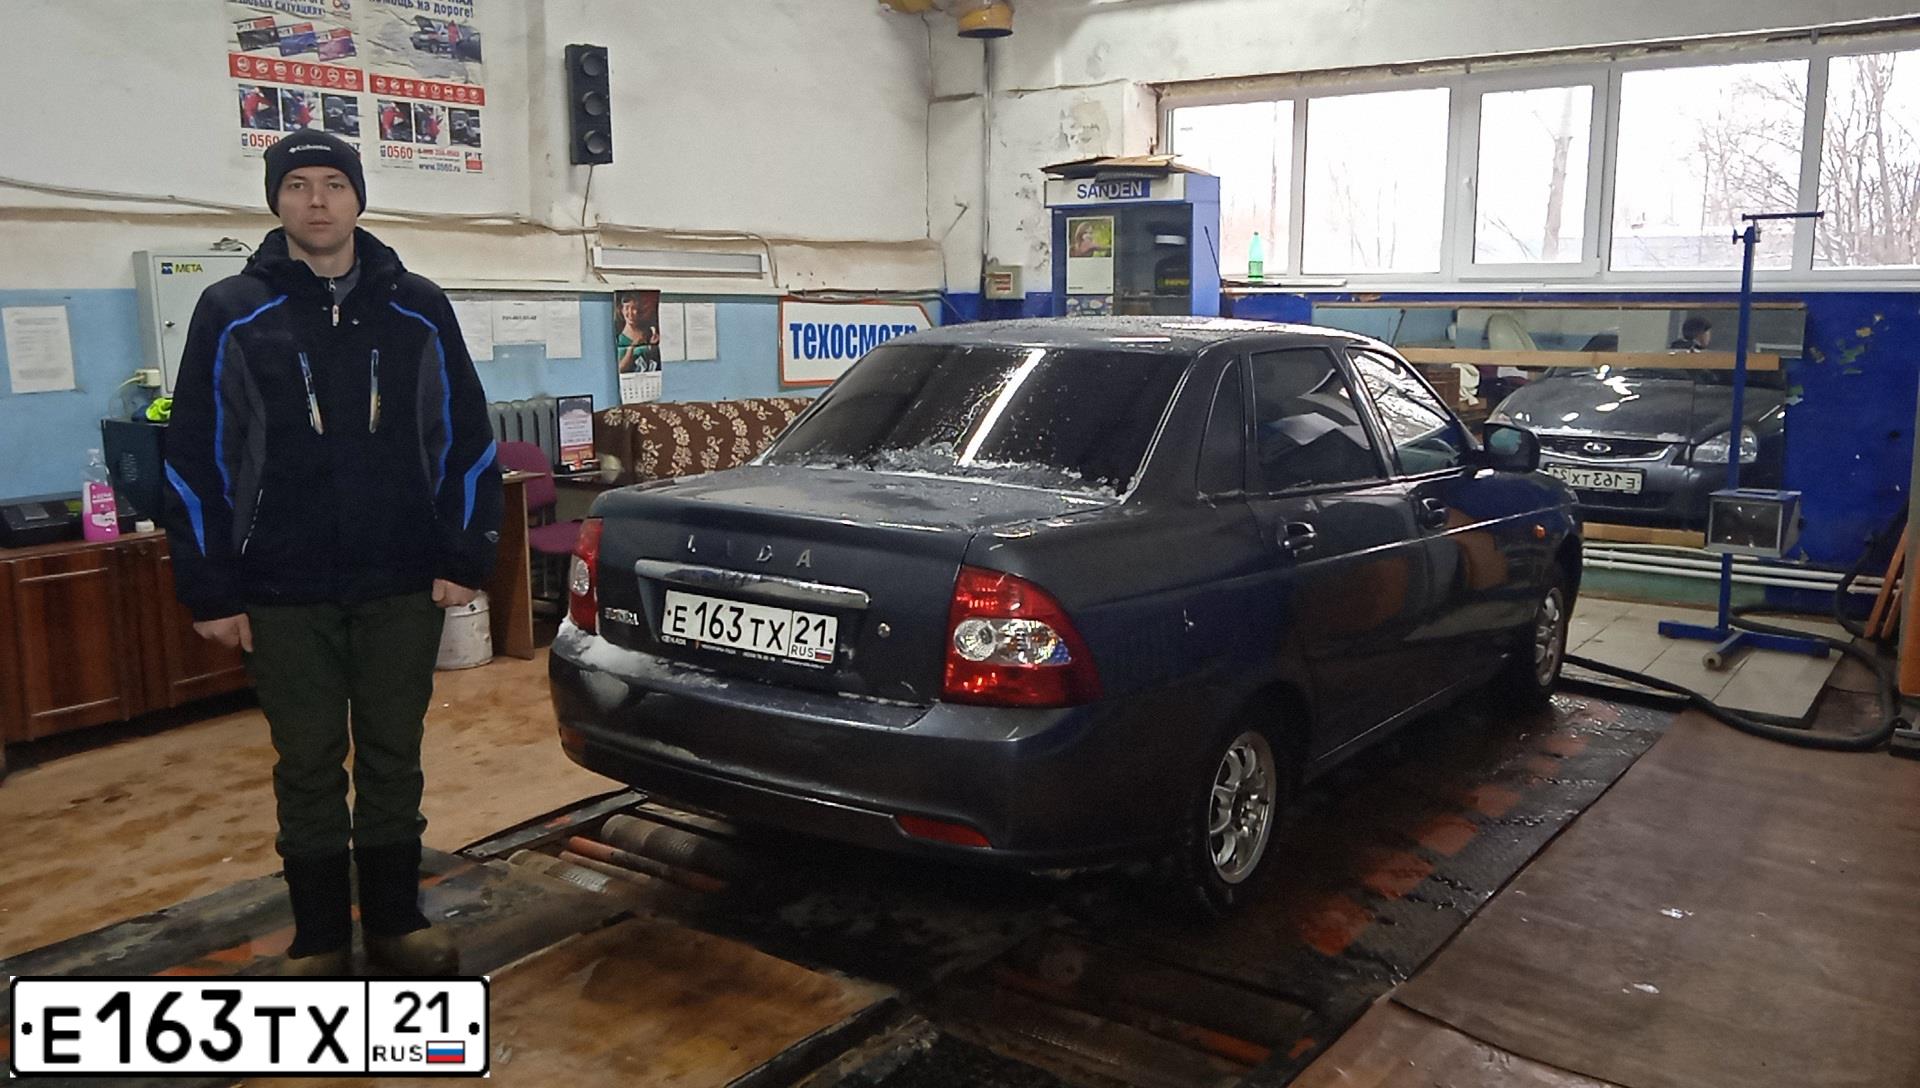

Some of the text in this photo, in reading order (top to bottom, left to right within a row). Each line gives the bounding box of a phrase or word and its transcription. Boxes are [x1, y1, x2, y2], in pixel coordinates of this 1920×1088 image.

[387, 145, 413, 159] 0560
[1077, 181, 1143, 199] SANDEN
[794, 616, 827, 647] 21
[791, 644, 814, 658] RUS
